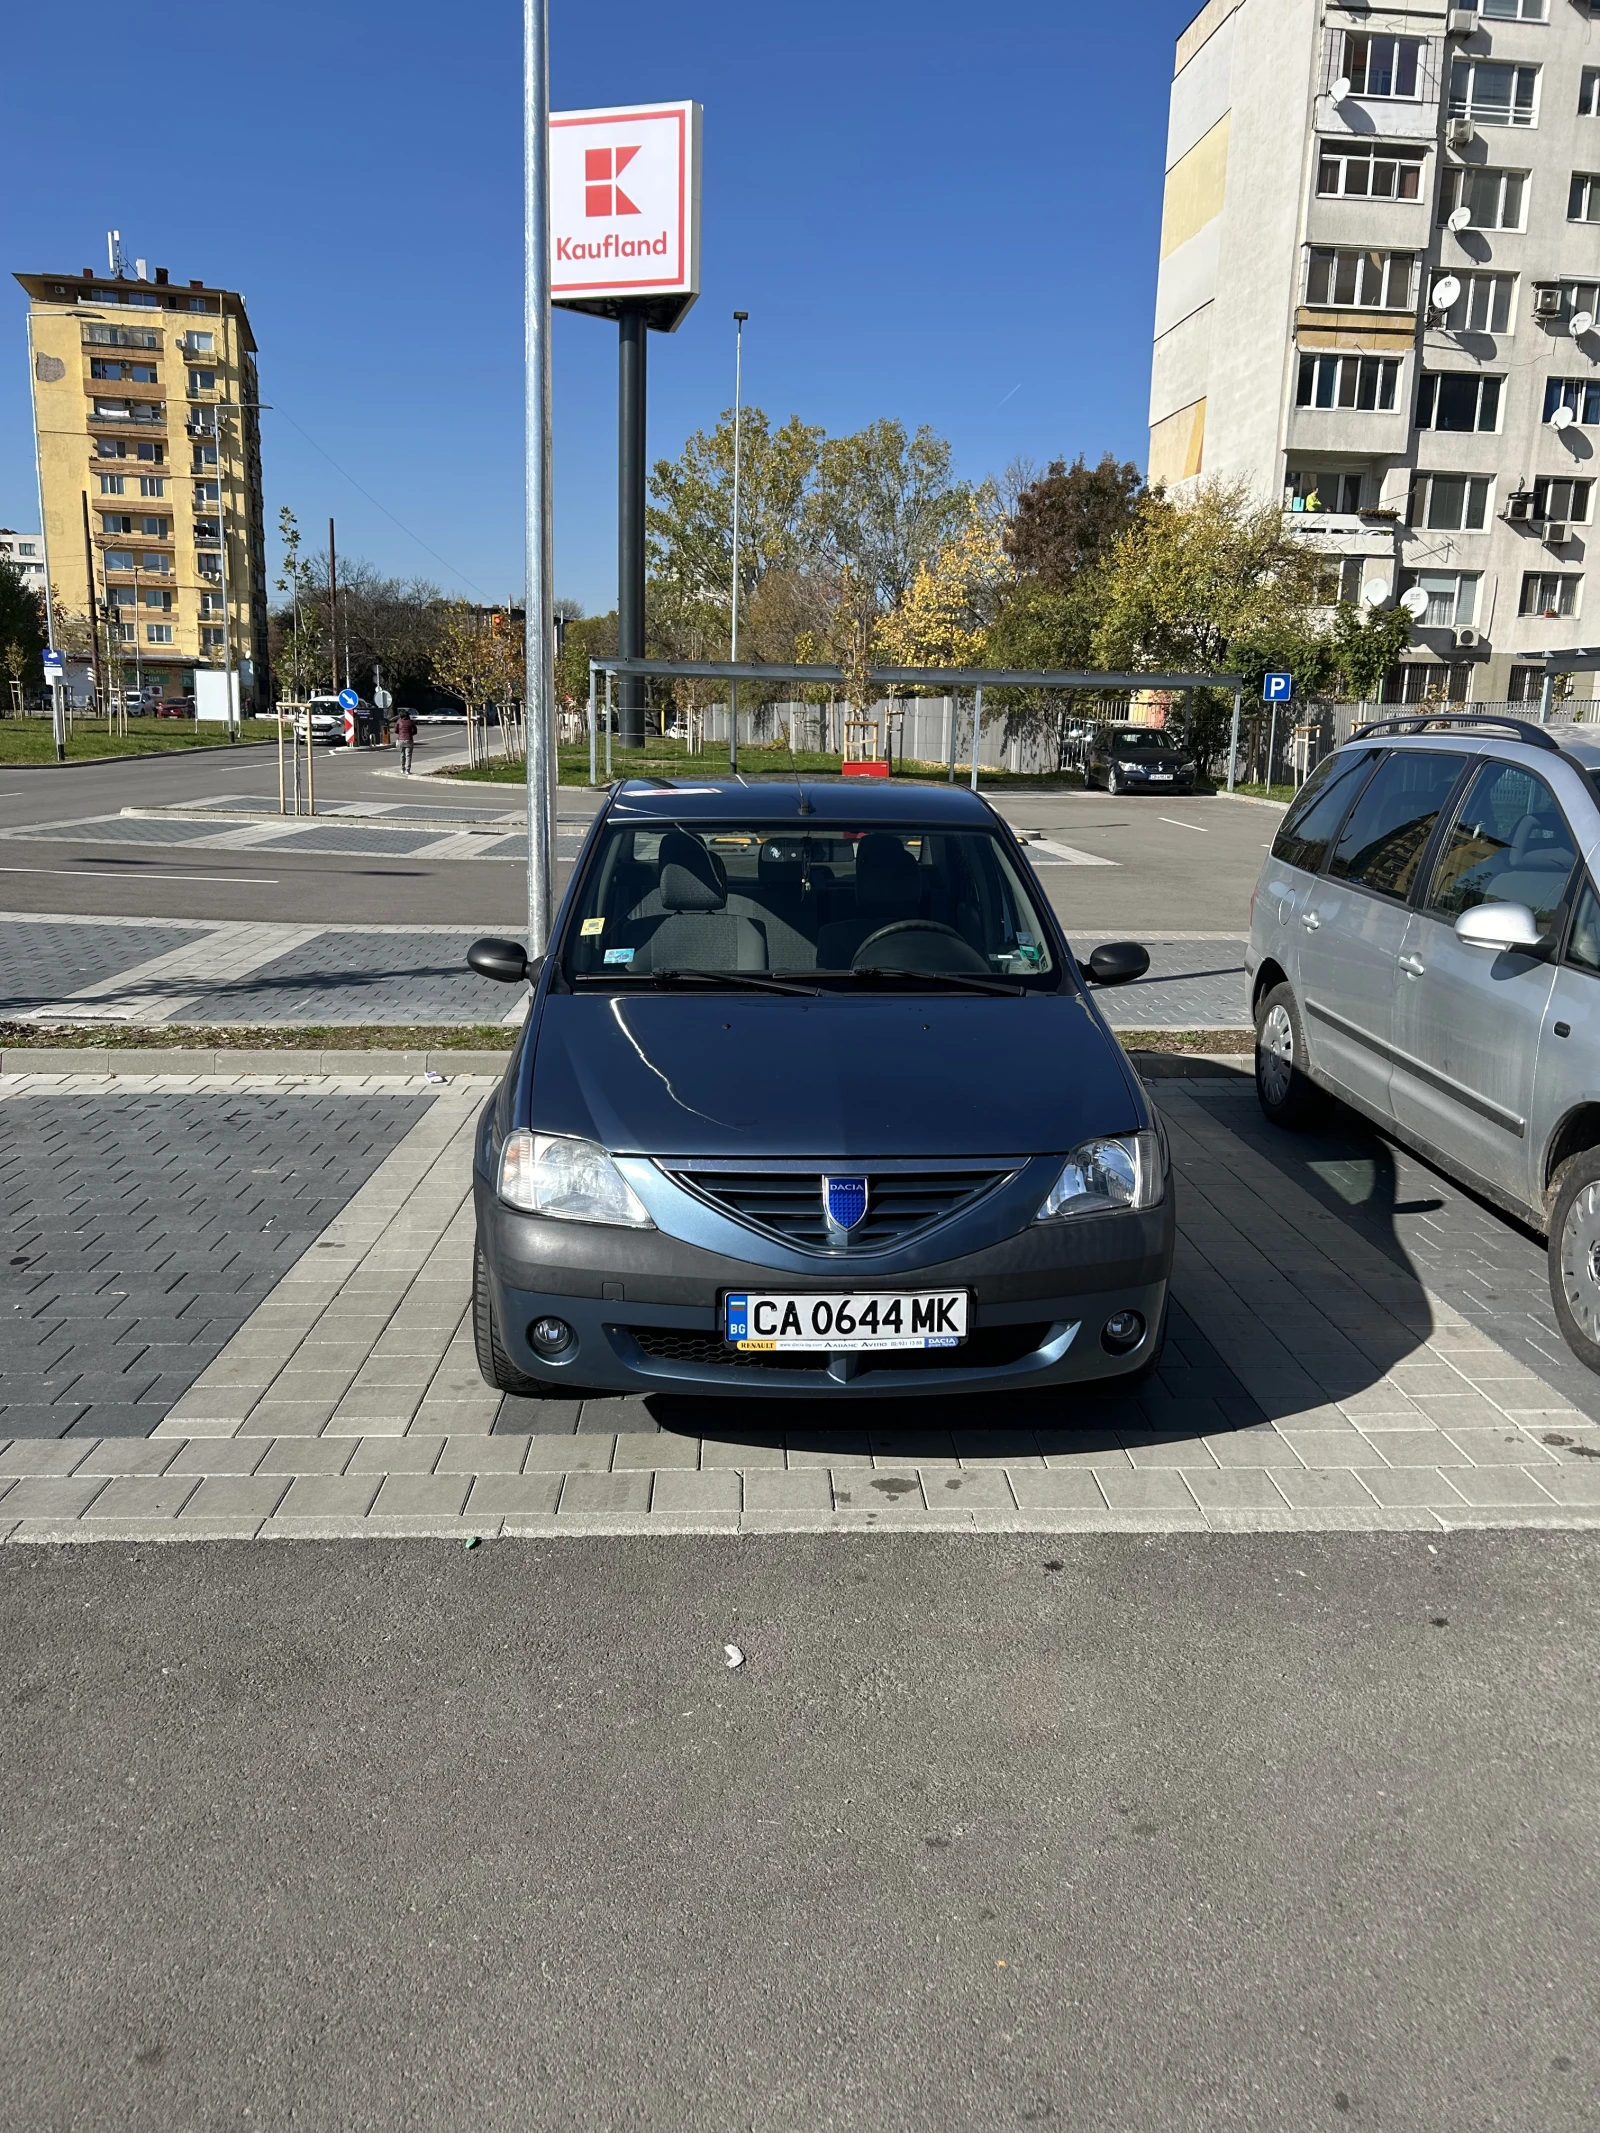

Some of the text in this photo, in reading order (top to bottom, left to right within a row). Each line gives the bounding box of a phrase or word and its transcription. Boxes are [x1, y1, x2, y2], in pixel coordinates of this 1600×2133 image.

[556, 231, 667, 260] Kaufland
[1270, 677, 1285, 697] P
[754, 1298, 959, 1335] CA 0644 MK
[730, 1324, 746, 1334] BG
